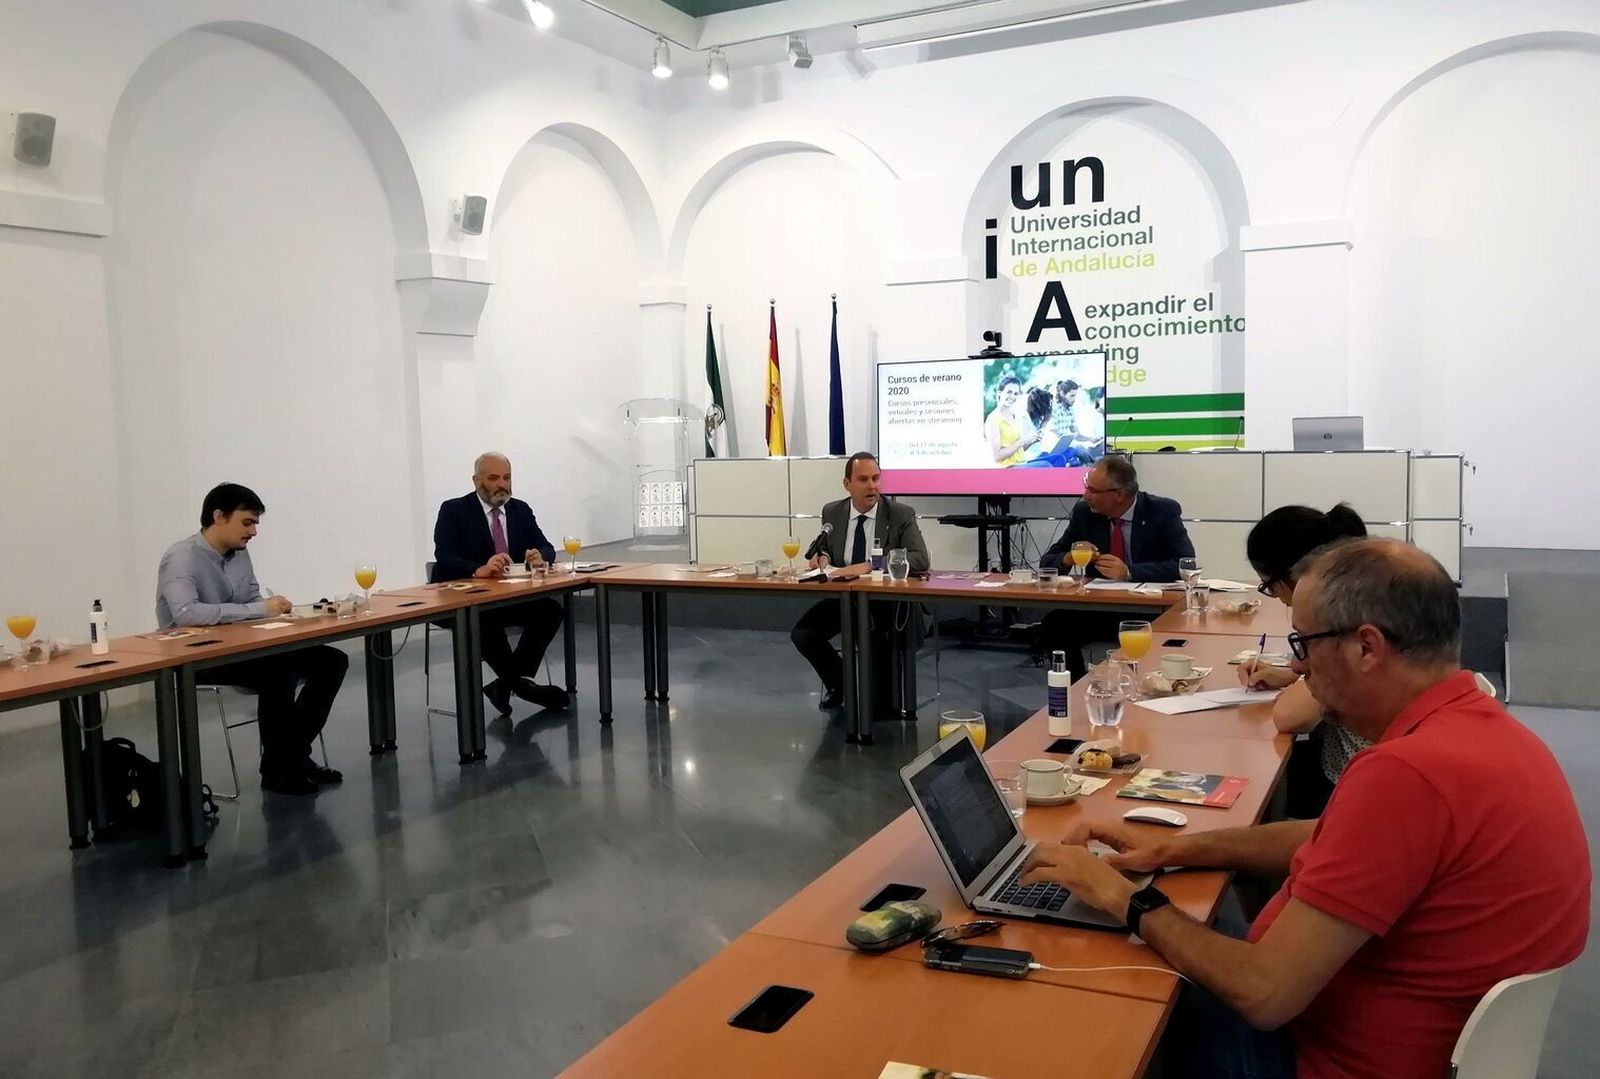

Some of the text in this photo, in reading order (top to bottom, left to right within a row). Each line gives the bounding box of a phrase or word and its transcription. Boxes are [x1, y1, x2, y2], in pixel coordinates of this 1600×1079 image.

[1010, 156, 1105, 211] un
[1010, 205, 1141, 234] Universidad
[985, 218, 998, 279] i
[1011, 226, 1154, 256] Internacional
[1012, 250, 1155, 278] de Andalucía
[1025, 280, 1082, 343] A
[1084, 292, 1214, 322] expandir el
[1084, 314, 1245, 341] conocimiento
[887, 373, 962, 385] Cursos de verano
[887, 386, 910, 396] 2020
